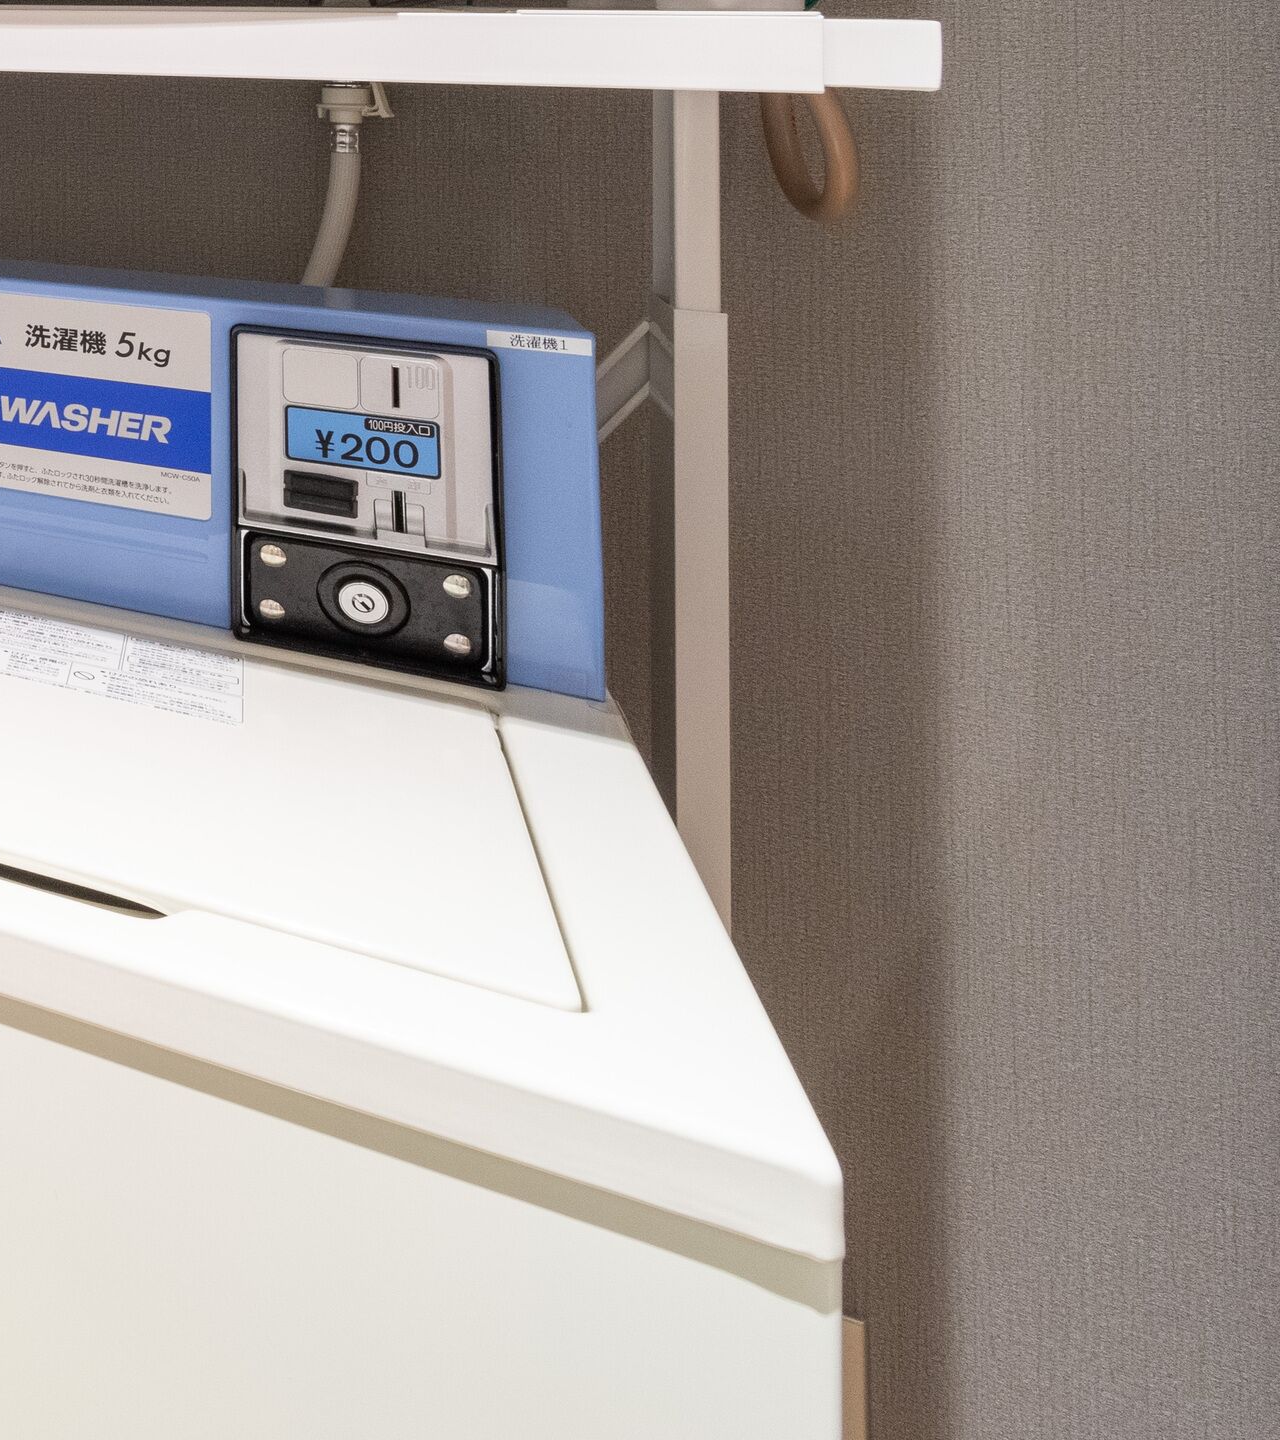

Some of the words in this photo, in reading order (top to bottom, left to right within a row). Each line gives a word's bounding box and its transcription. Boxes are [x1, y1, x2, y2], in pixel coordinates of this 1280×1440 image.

[24, 324, 106, 355] 洗濯機
[114, 331, 171, 368] 5kg
[509, 333, 568, 351] 洗濯機1
[0, 394, 172, 445] WASHER
[367, 419, 431, 437] 100円投入口
[314, 428, 420, 469] ¥200
[160, 471, 201, 483] MCW-C50A
